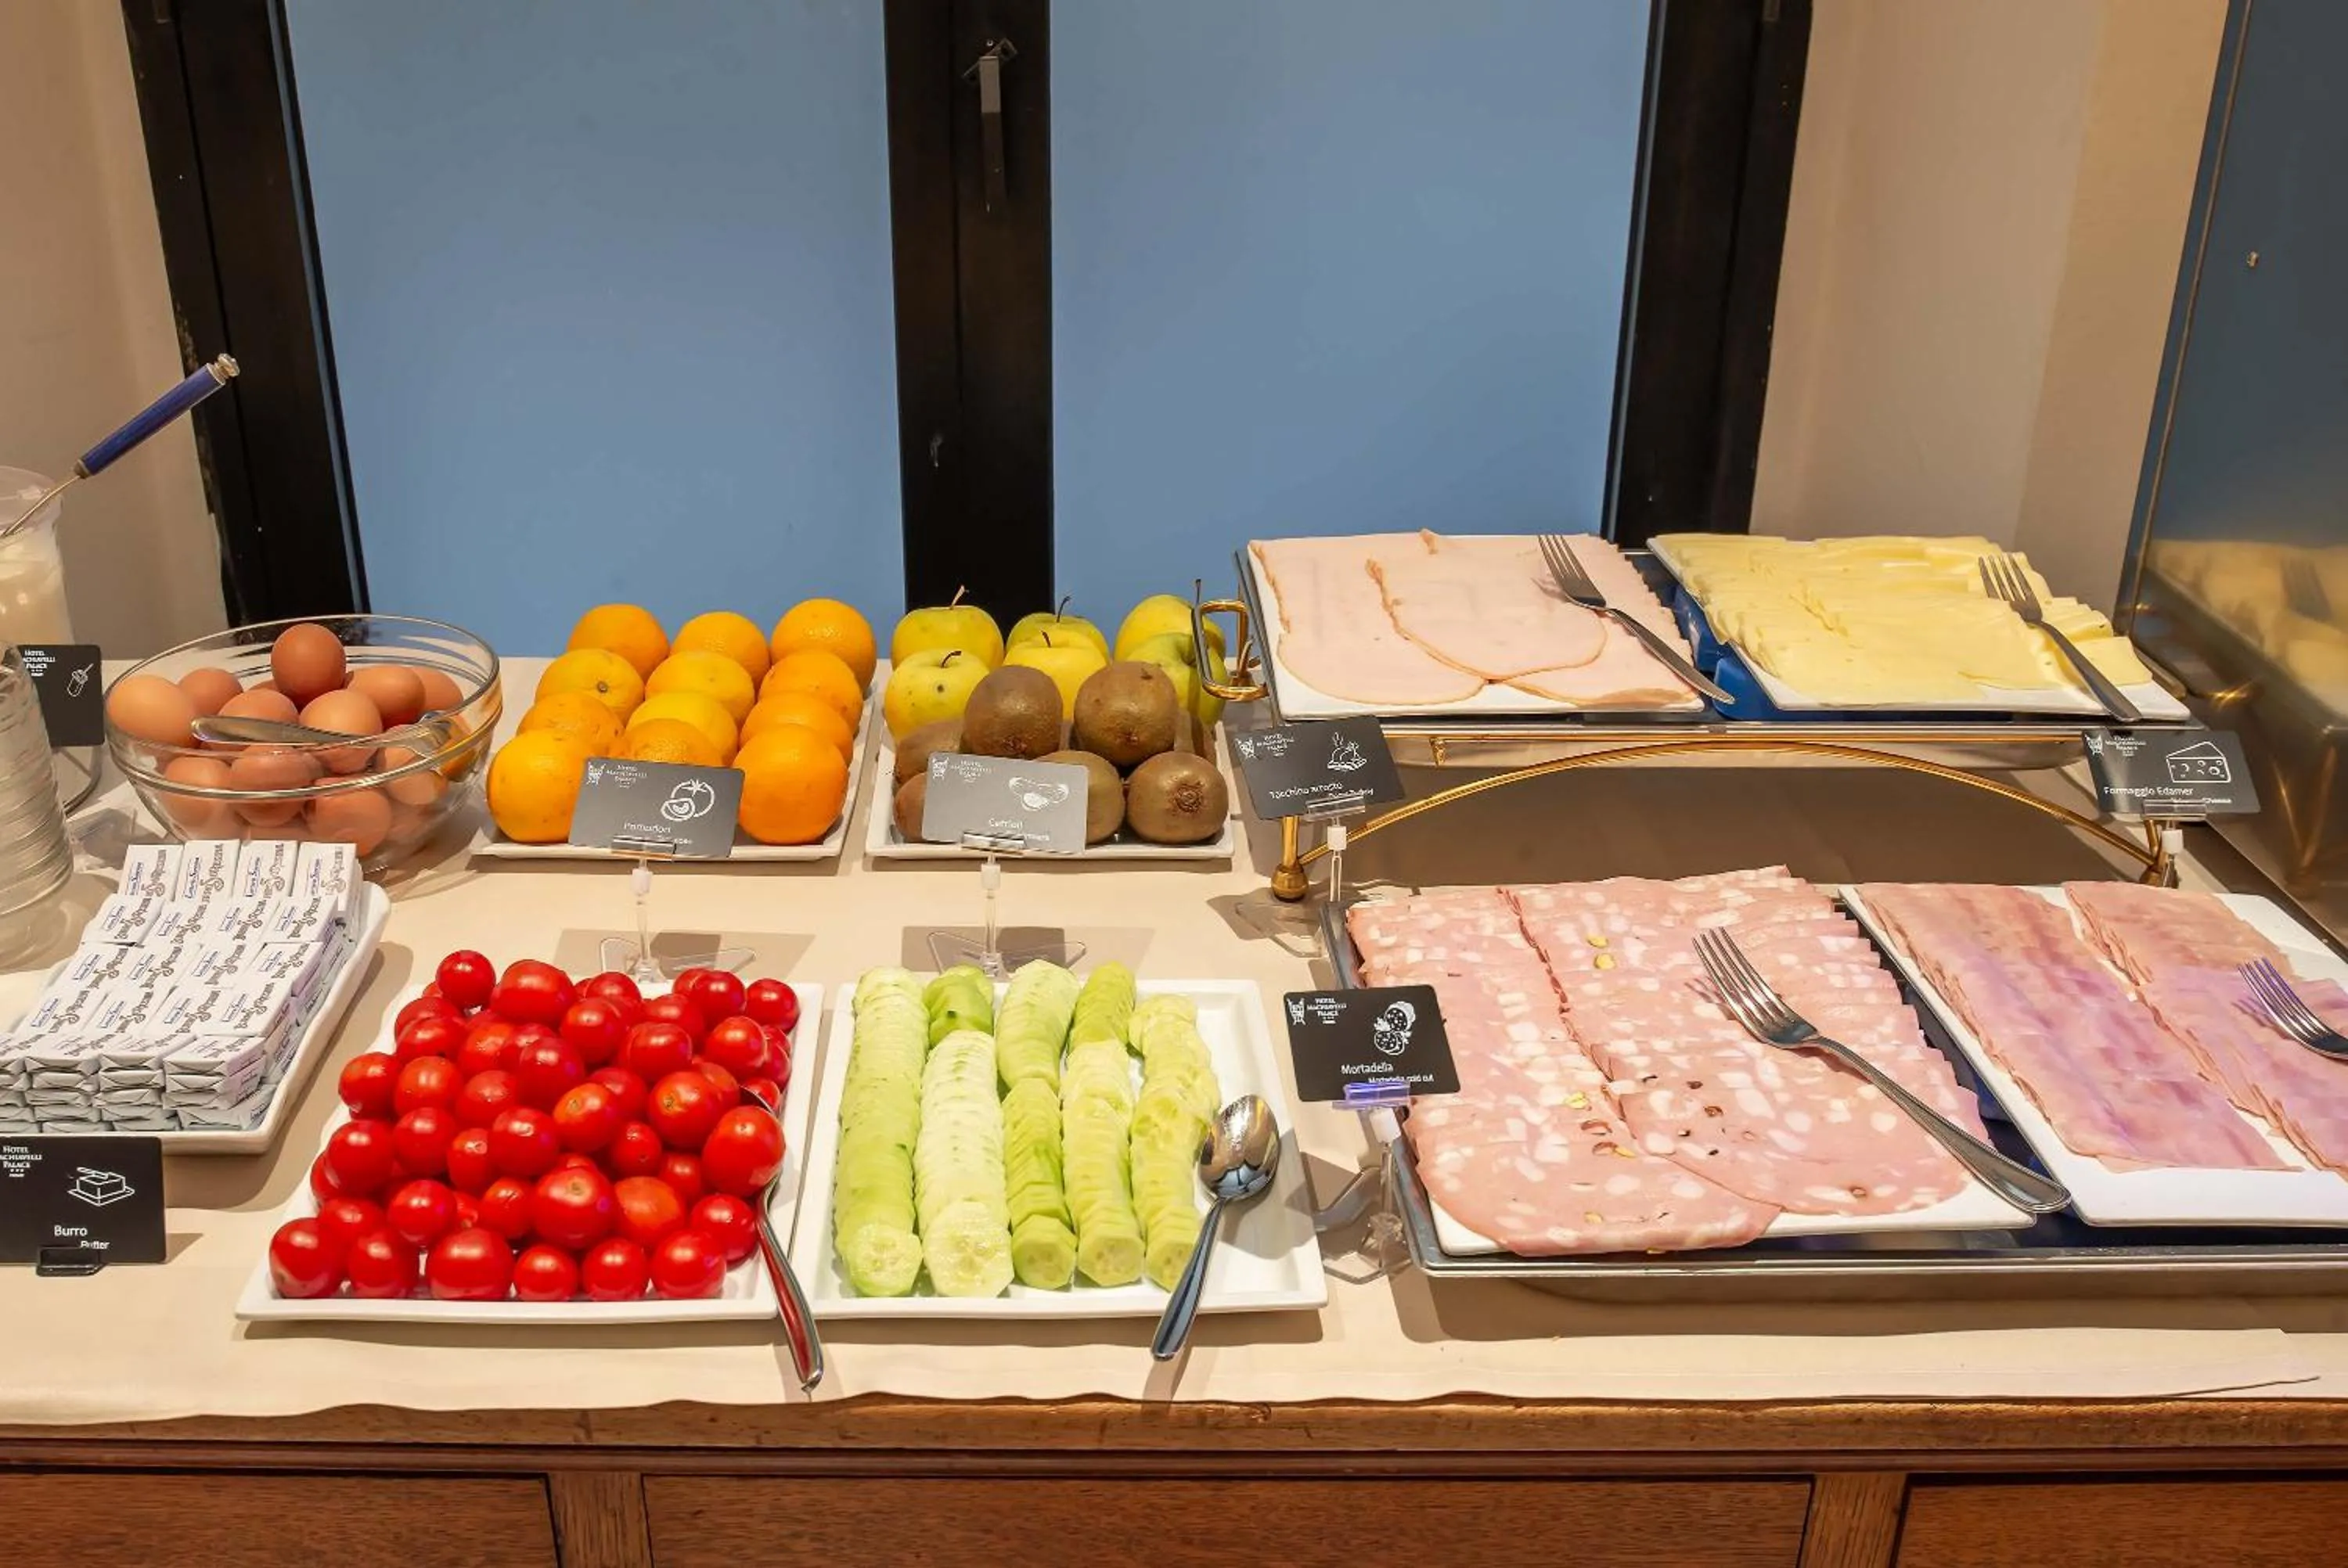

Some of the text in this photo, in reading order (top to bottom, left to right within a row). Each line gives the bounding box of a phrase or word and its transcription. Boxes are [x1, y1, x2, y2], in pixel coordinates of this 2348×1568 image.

[2104, 786, 2194, 797] Formaggio Edamer
[1340, 1062, 1394, 1074] Mortadella
[54, 1225, 88, 1237] Burro
